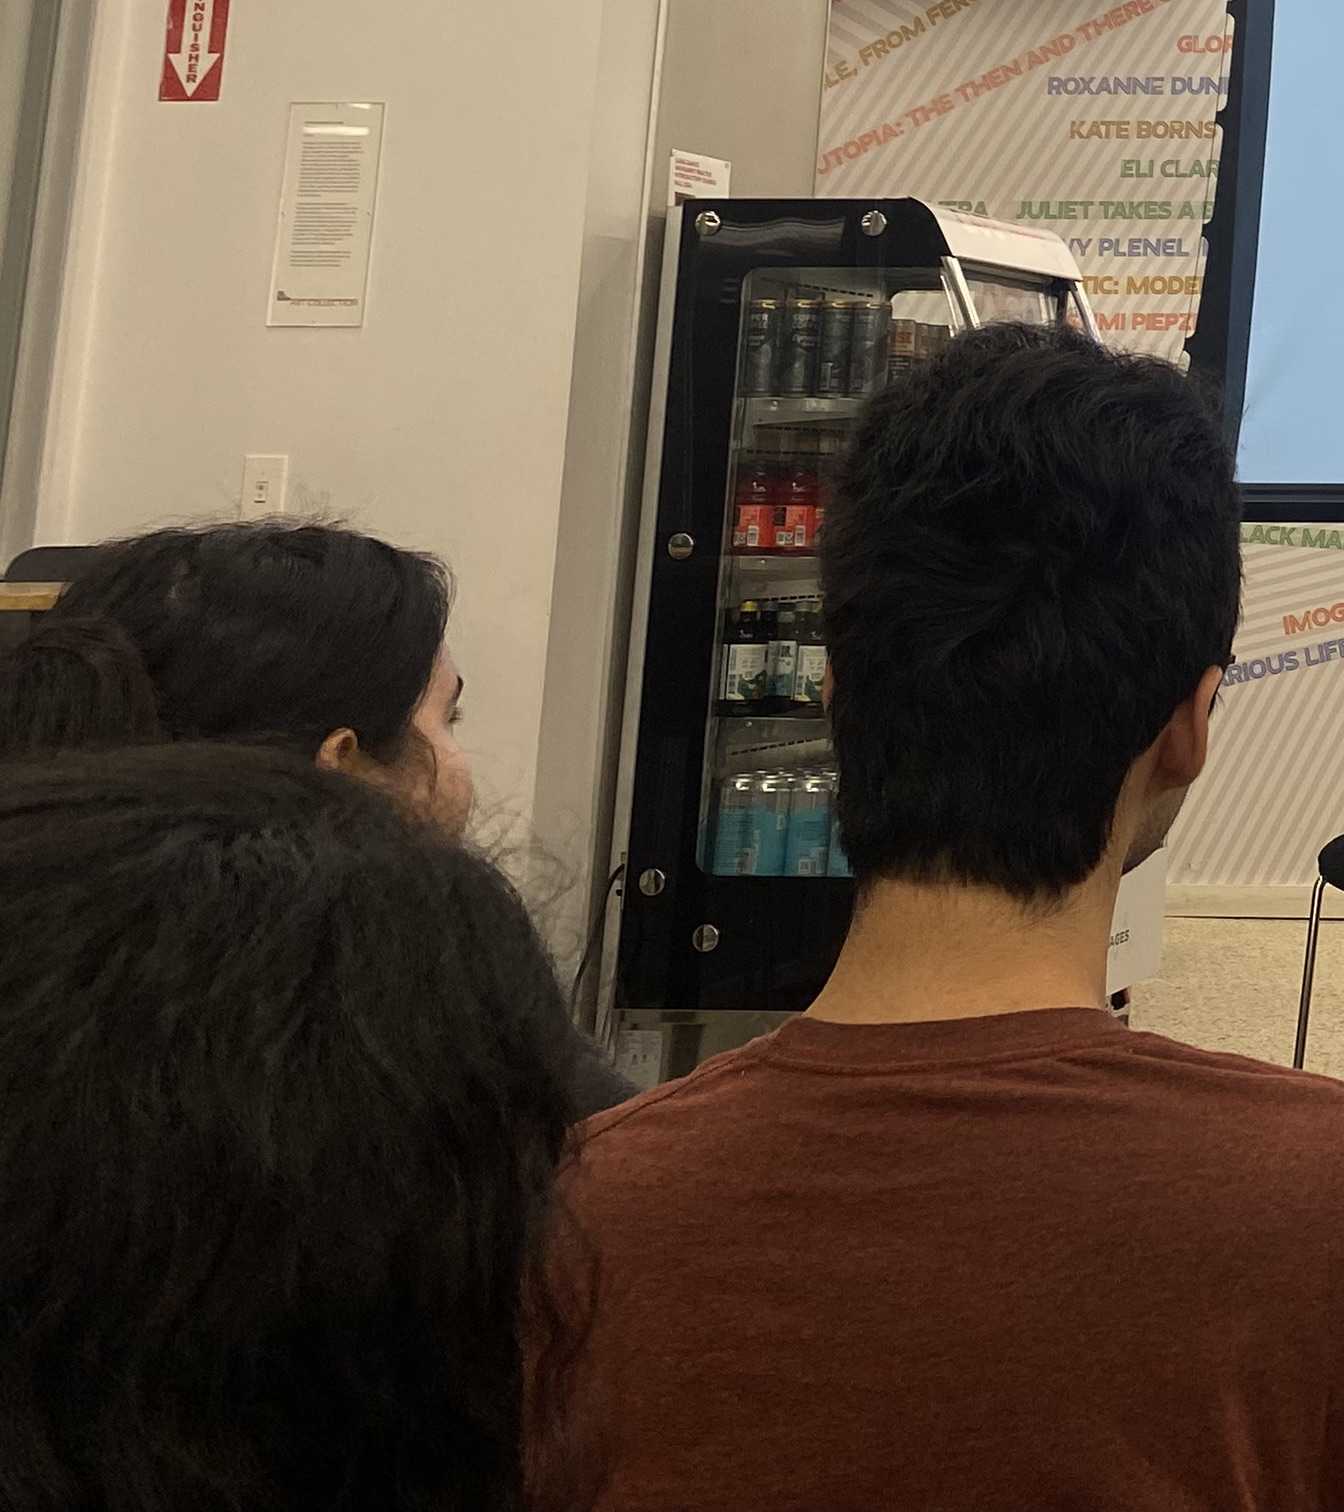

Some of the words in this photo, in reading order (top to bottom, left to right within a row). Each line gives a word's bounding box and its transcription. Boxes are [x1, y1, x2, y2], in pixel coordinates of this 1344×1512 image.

[857, 15, 927, 67] FROM
[904, 92, 956, 128] THE
[953, 58, 1024, 103] THEN
[1025, 33, 1077, 72] AND
[1047, 75, 1166, 96] ROXANNE
[1070, 120, 1131, 140] KATE
[1119, 159, 1155, 178] ELI
[1016, 200, 1095, 221] JULIET
[1099, 200, 1173, 221] TAKES
[1176, 200, 1196, 221] A
[1097, 238, 1190, 258] PLENEL
